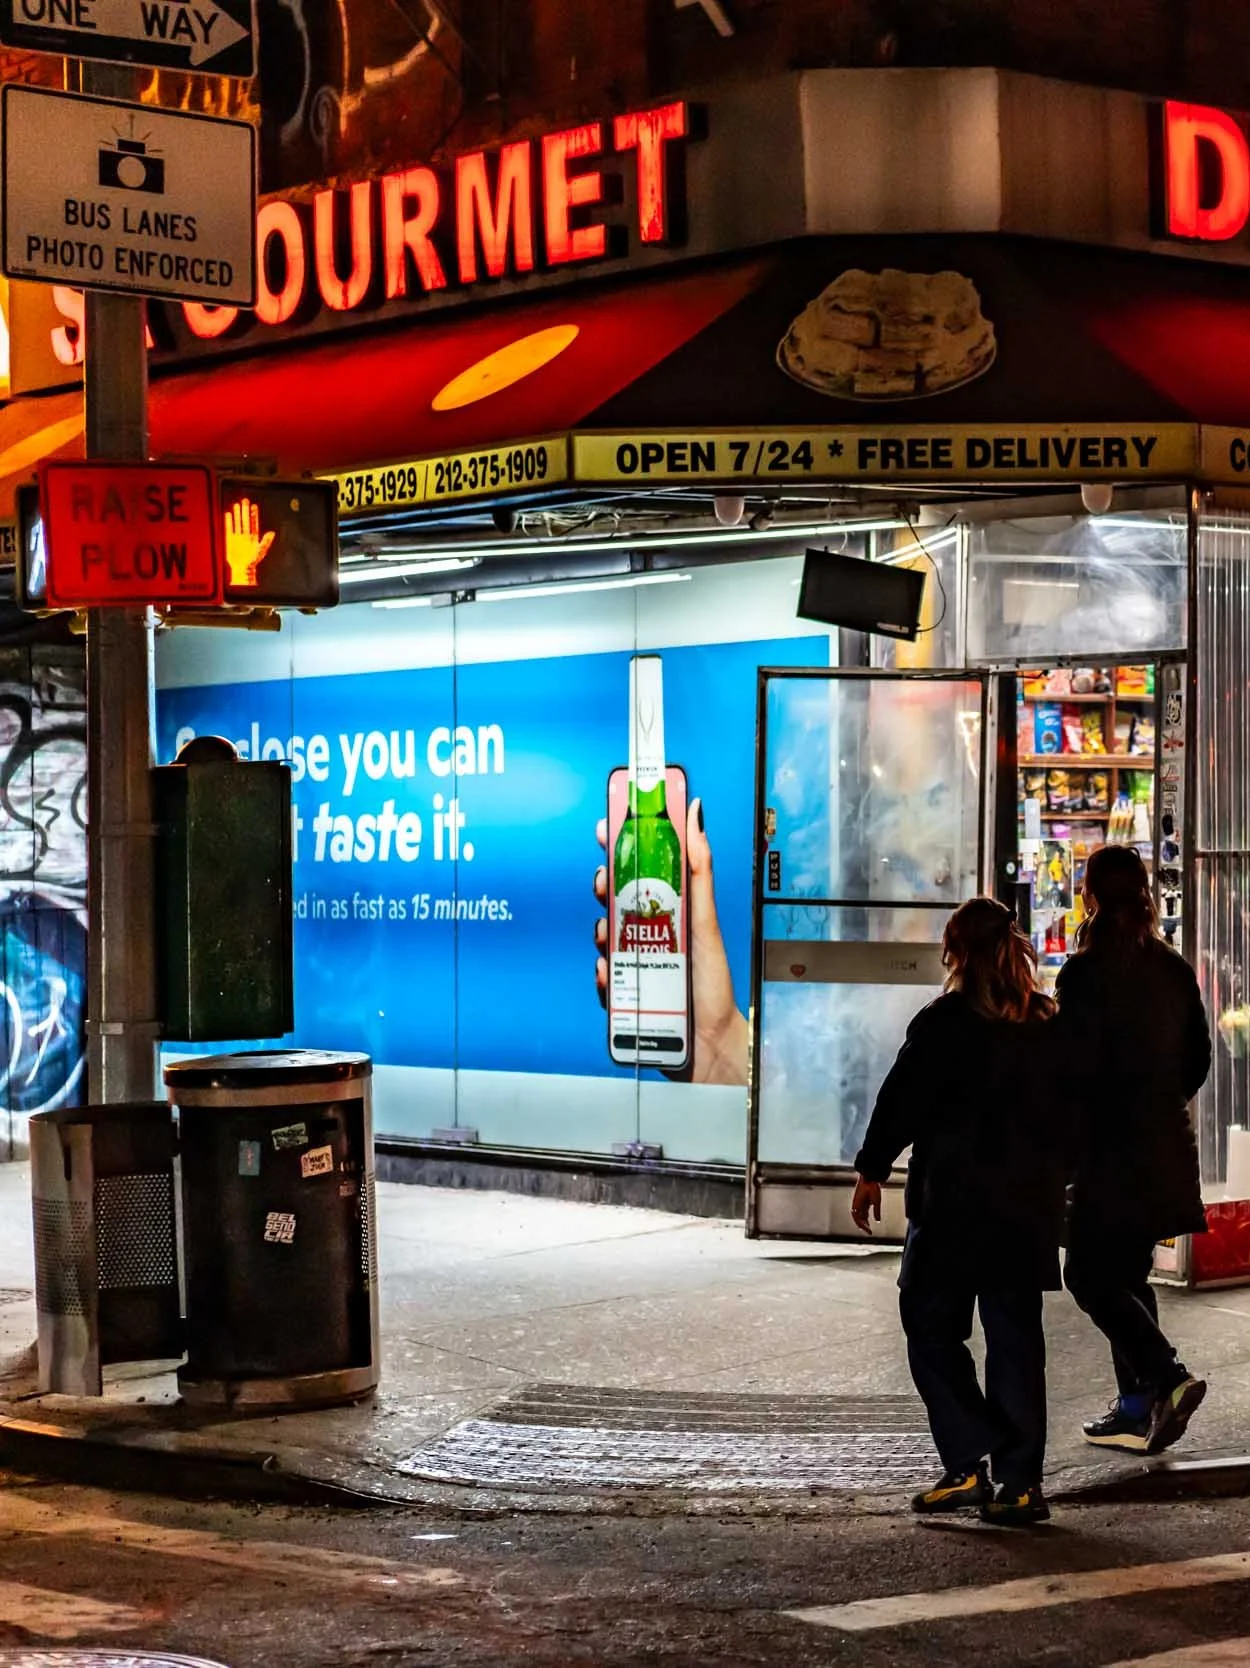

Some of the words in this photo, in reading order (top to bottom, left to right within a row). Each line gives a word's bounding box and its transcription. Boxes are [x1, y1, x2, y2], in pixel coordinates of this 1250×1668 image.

[21, 0, 97, 29] ONE
[141, 2, 219, 45] WAY
[65, 199, 111, 231] BUS
[122, 206, 197, 242] LANES
[184, 101, 686, 339] OURMET
[27, 235, 103, 271] PHOTO
[115, 247, 234, 288] ENFORCED
[434, 446, 547, 494] 212-375-1909
[615, 442, 716, 473] OPEN
[729, 440, 814, 475] 7/24
[857, 438, 953, 469] FREE
[966, 436, 1158, 468] DELIVERY
[70, 484, 189, 523] RAISE
[80, 543, 188, 583] PLOW
[338, 728, 416, 797] you
[427, 723, 505, 778] can
[312, 799, 423, 864] taste
[432, 793, 475, 862] it.
[312, 892, 327, 919] in
[330, 899, 349, 919] as
[353, 891, 384, 920] fast
[388, 899, 407, 920] as
[411, 892, 431, 920] 15
[434, 891, 514, 921] minutes.
[626, 924, 671, 941] STELLA
